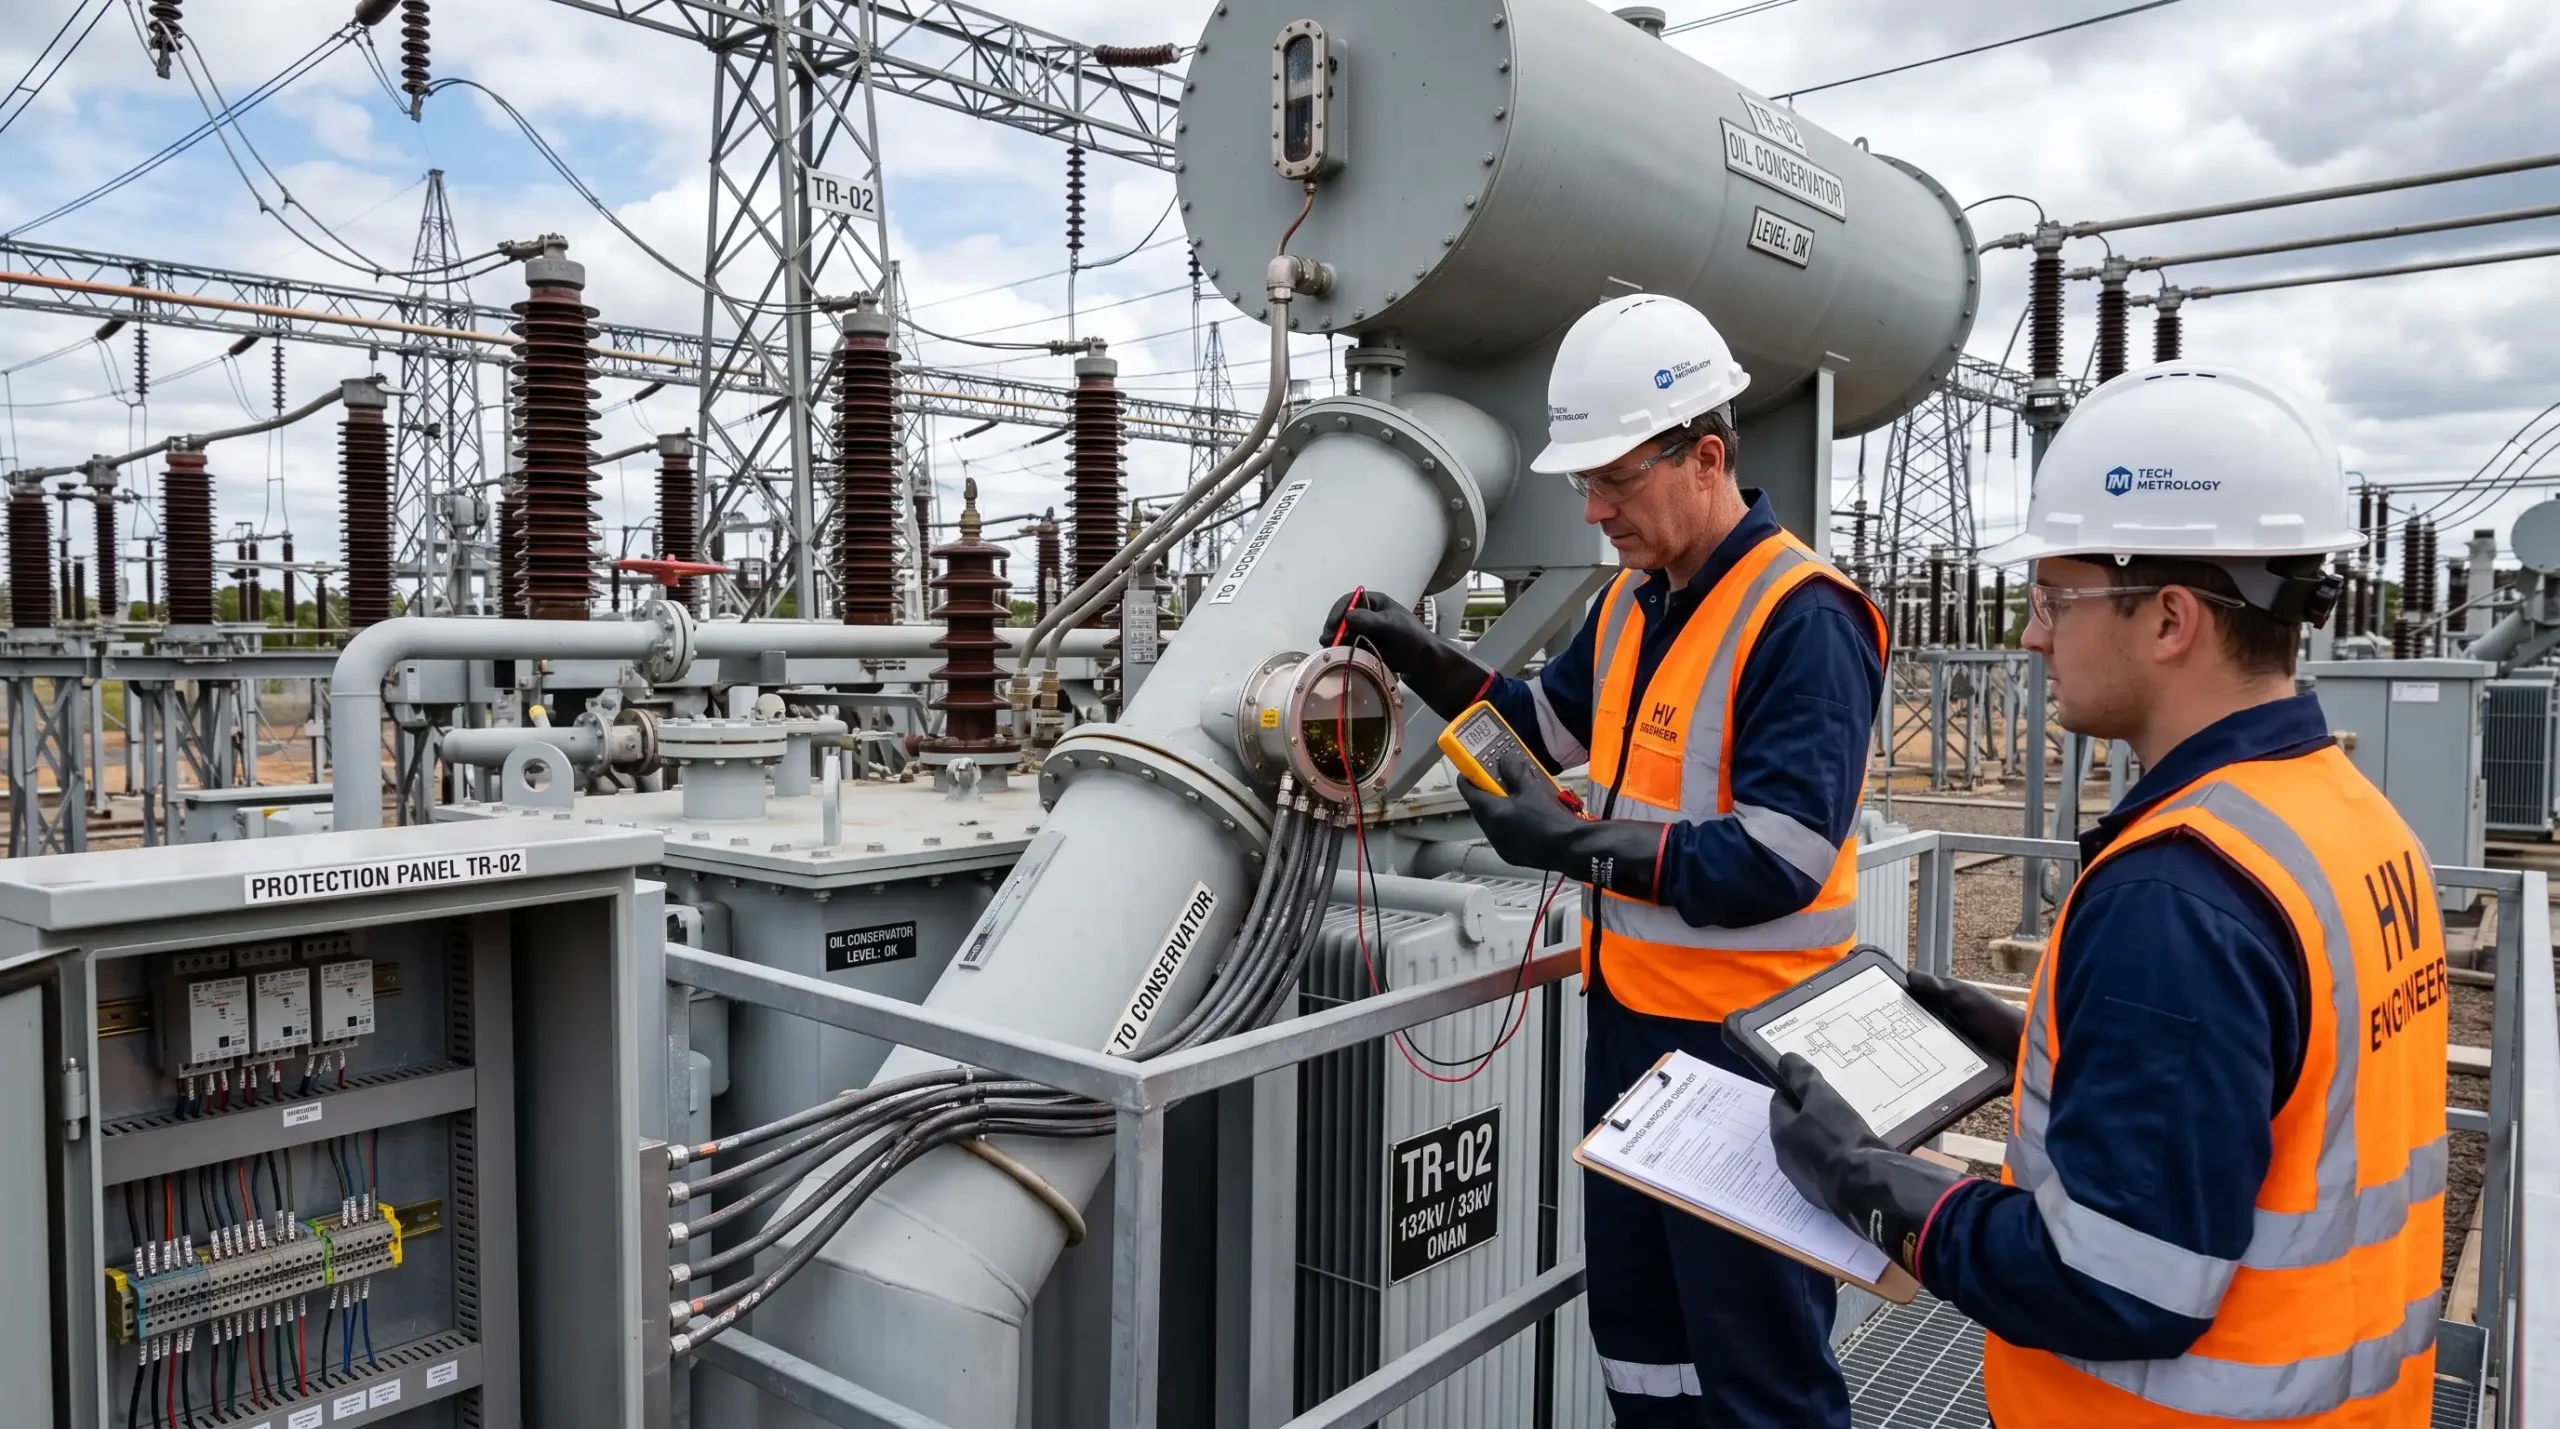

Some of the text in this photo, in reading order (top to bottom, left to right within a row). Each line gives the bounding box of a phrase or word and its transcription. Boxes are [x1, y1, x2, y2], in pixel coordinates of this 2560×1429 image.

[1749, 102, 1805, 150] TR-02
[1729, 132, 1842, 208] OIL CONSERVATOR
[812, 176, 874, 213] TR-02
[1756, 218, 1810, 258] LEVEL: OK
[2137, 480, 2221, 491] METROLOGY
[2138, 468, 2173, 479] TECH
[1216, 584, 1236, 600] TO
[1652, 702, 1677, 727] HV
[252, 853, 522, 900] PROTECTION PANEL TR-02
[2364, 850, 2420, 973] HV
[829, 926, 914, 949] OIL CONSERVATOR
[847, 944, 898, 963] LEVEL: OK
[1113, 890, 1214, 1050] TO CONSERVATOR
[2370, 957, 2448, 1053] ENGINEER
[1401, 1123, 1493, 1204] TR-02
[1399, 1182, 1493, 1242] 132kV / 33kV
[1427, 1222, 1467, 1260] ONAN
